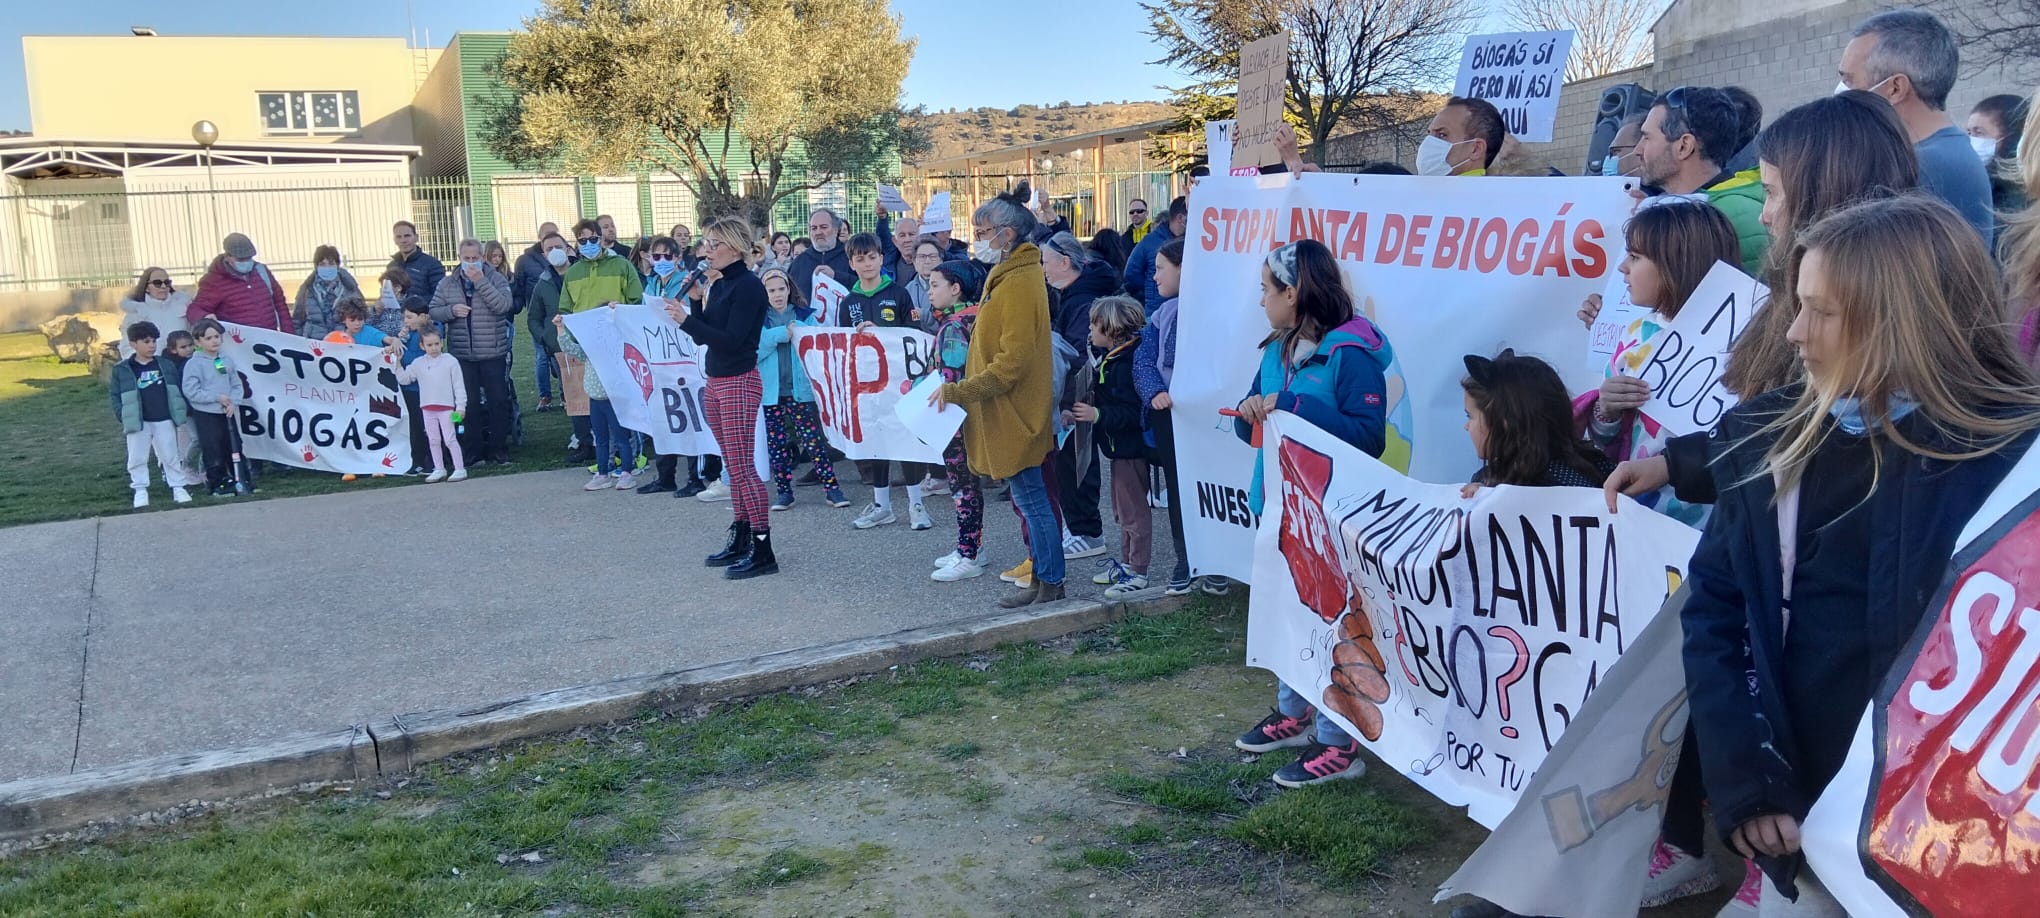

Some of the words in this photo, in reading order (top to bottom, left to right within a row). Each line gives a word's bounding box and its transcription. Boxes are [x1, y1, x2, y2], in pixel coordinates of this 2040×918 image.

[1468, 74, 1504, 98] PERO
[1525, 67, 1559, 98] ASÍ
[1201, 206, 1261, 254] STOP
[1259, 207, 1368, 262] PLANTA
[1374, 213, 1433, 267] DE
[1431, 202, 1607, 279] BIOGÁS
[252, 343, 372, 387] STOP
[285, 382, 356, 405] PLANTA
[799, 332, 890, 443] STOP
[1338, 489, 1623, 656] MACROPLANTA
[1446, 730, 1486, 777] POR
[1494, 752, 1524, 792] TU
